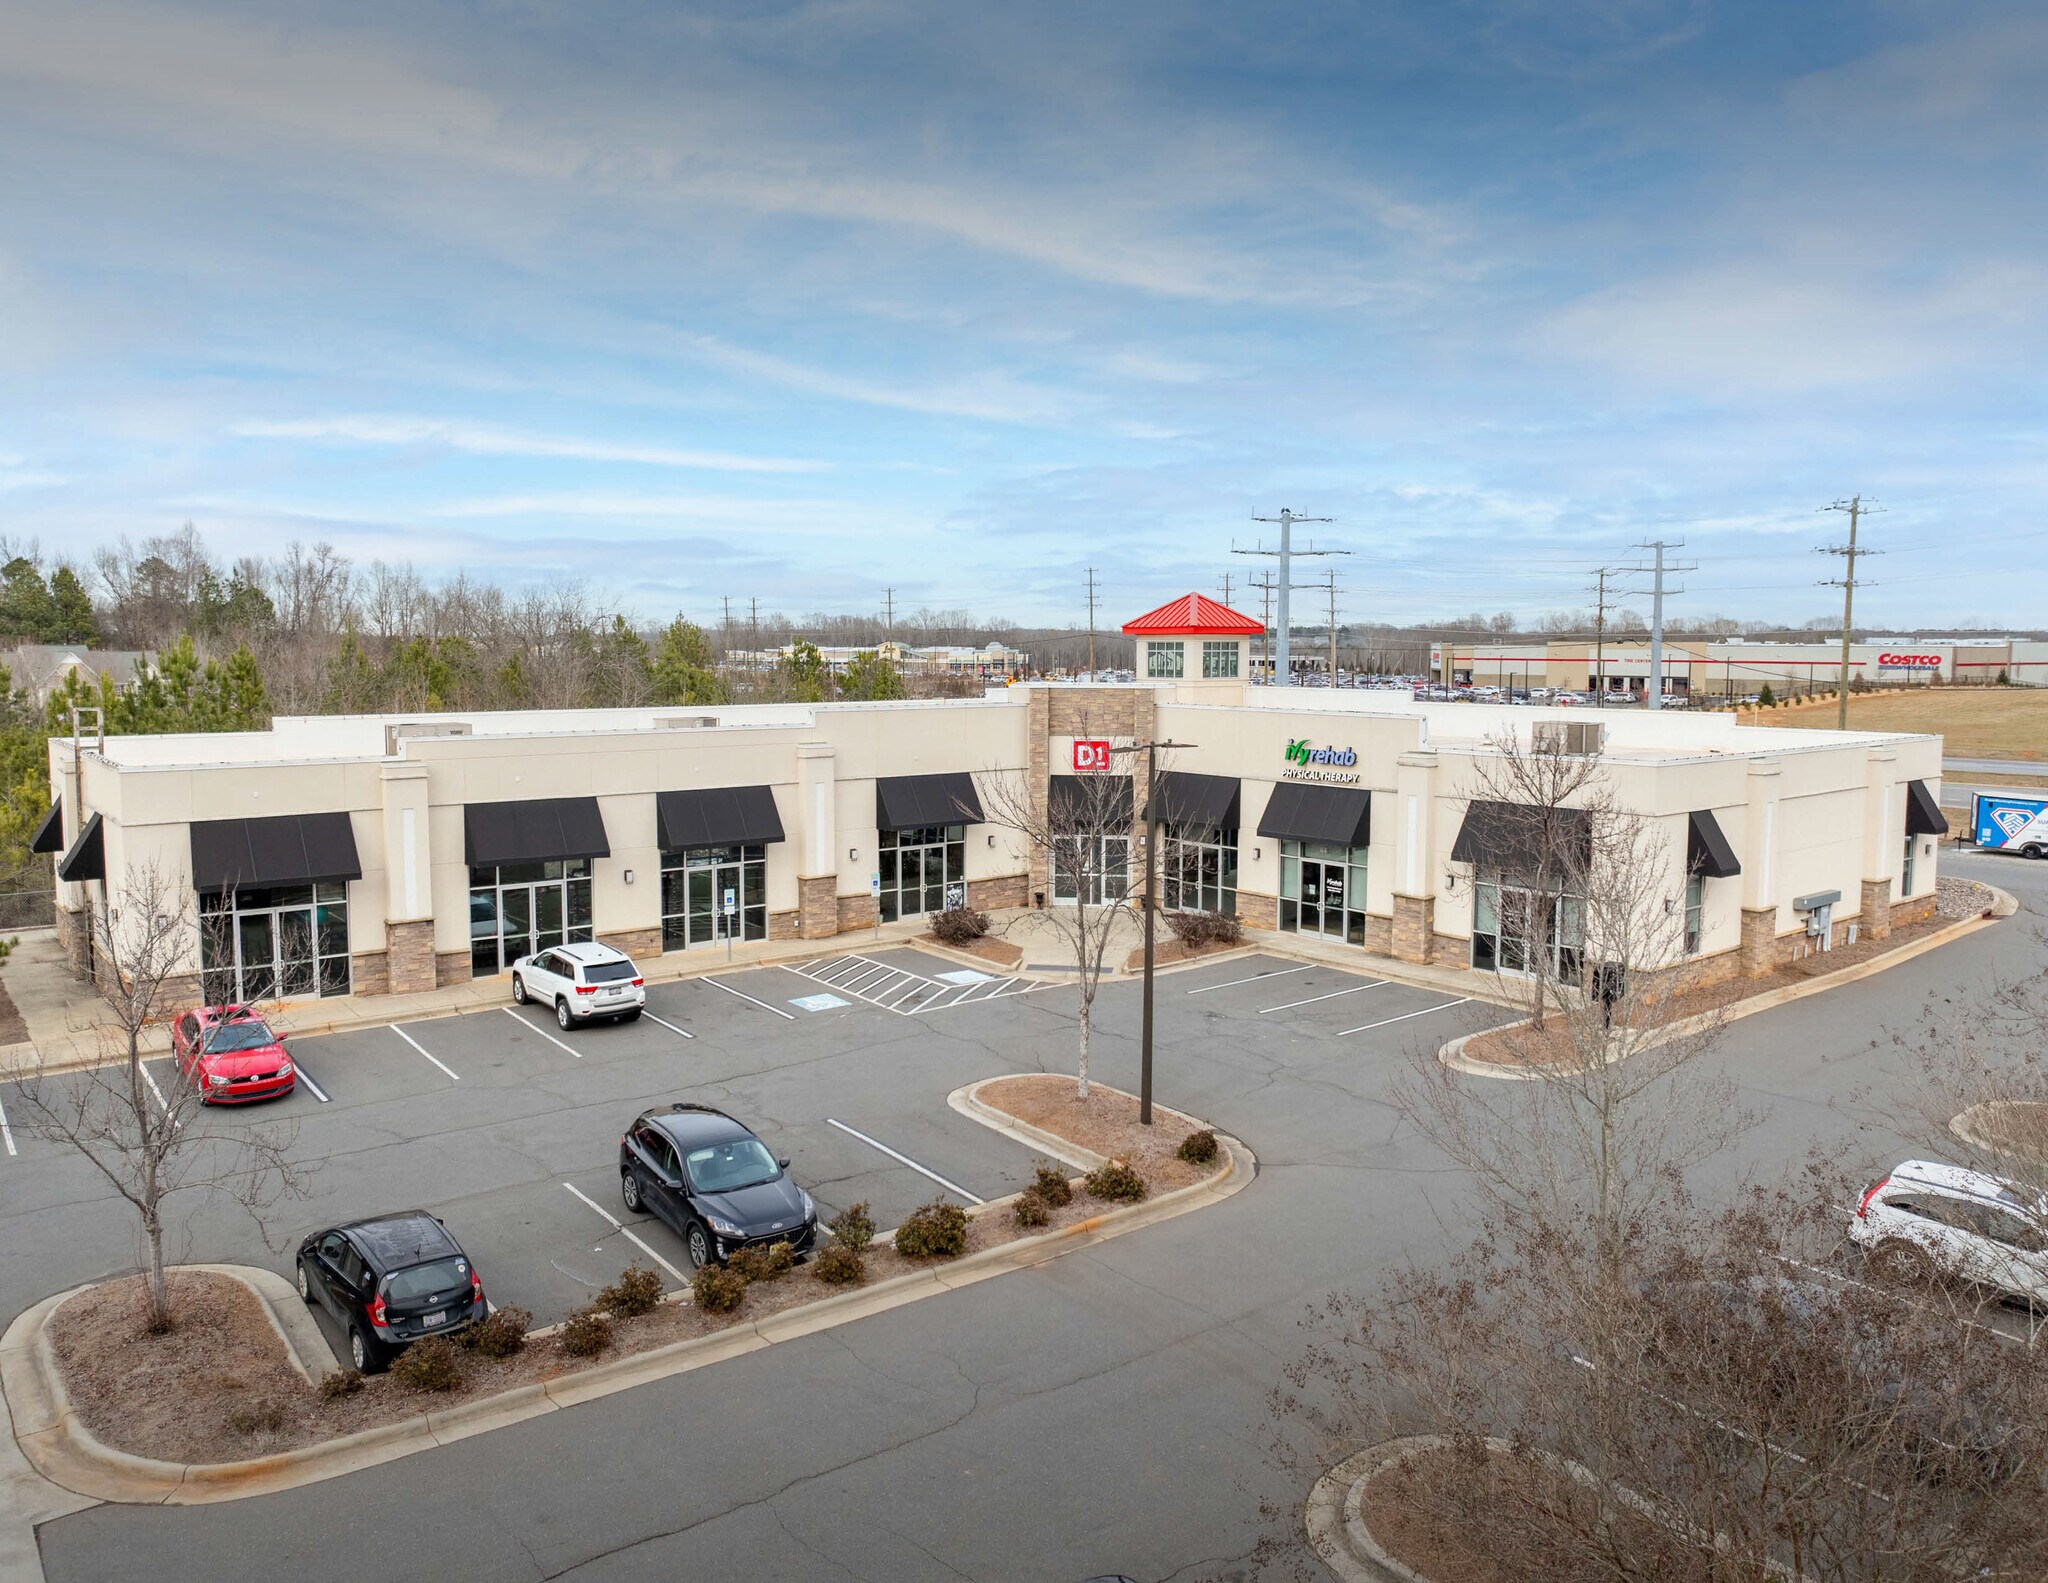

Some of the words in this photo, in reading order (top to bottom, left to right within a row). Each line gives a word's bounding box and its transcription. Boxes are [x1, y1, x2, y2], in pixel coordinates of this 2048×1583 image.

[1878, 653, 1942, 665] COSTCO
[1077, 745, 1103, 766] D1
[1281, 768, 1320, 781] PHYSICAL
[1320, 772, 1360, 784] THERAPY
